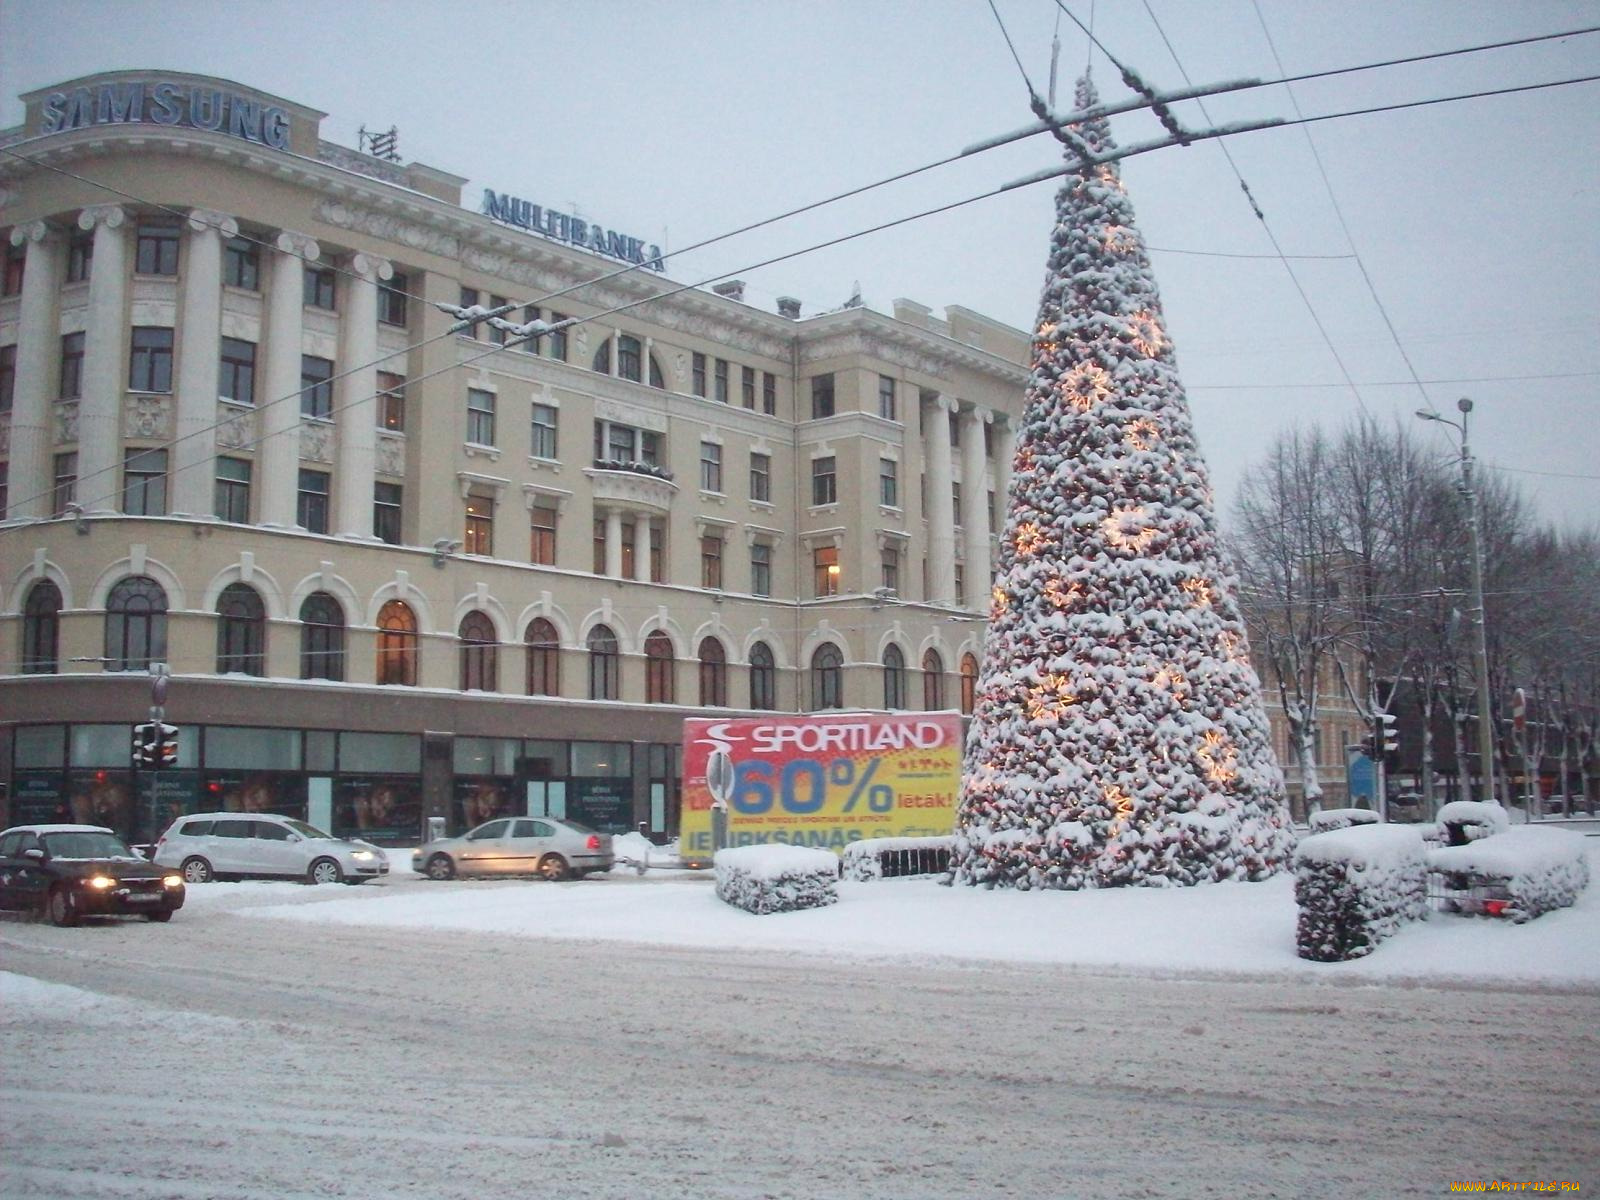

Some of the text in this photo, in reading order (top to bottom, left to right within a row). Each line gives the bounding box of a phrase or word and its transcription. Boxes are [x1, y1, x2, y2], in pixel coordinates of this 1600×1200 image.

[41, 82, 290, 149] SAMSUNG
[483, 188, 665, 273] MULTIBANKA
[752, 721, 945, 752] SPORTLAND
[732, 757, 894, 814] 60%
[689, 826, 863, 852] IEIRKŠANĀS
